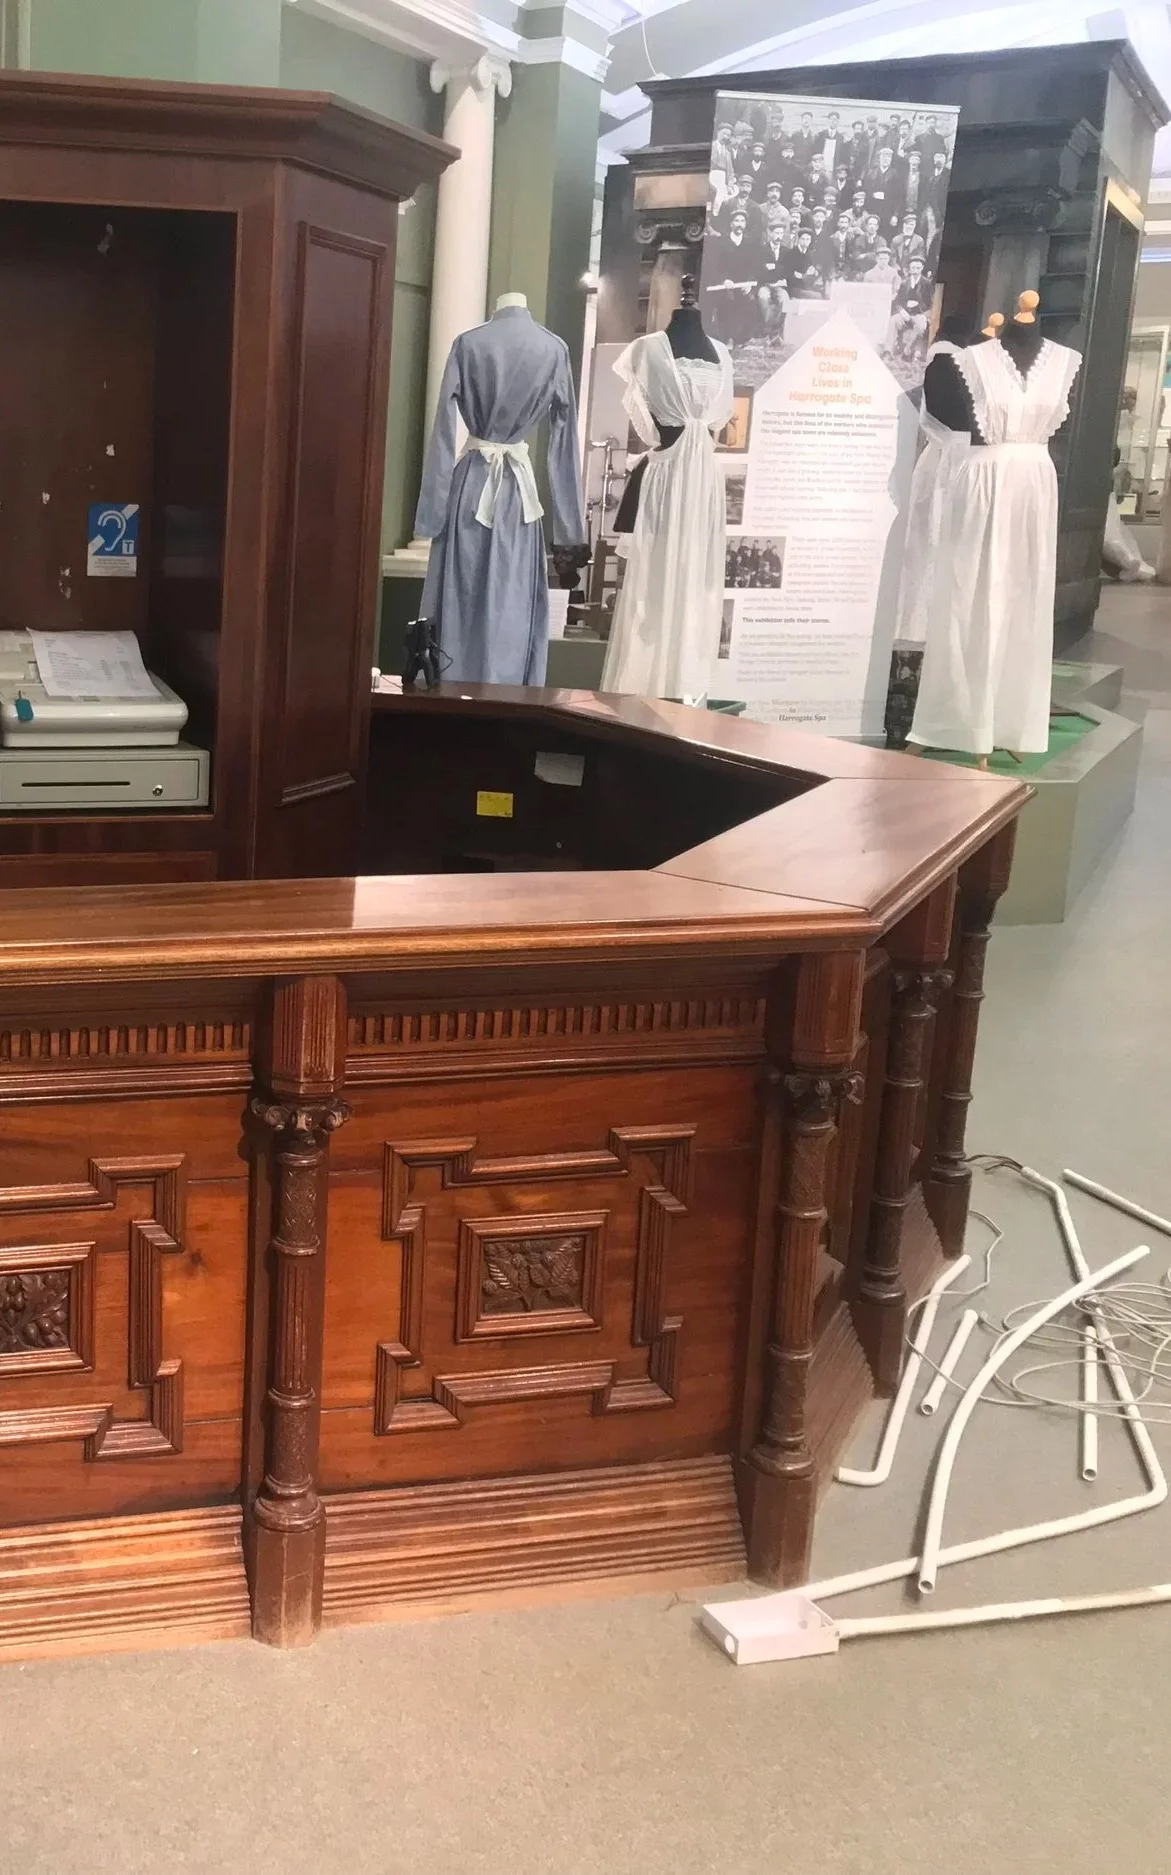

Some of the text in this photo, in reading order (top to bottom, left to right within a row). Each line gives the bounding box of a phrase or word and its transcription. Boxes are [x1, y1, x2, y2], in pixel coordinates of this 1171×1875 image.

[812, 346, 858, 361] Working
[818, 361, 849, 373] Class
[812, 376, 853, 388] Lives in
[788, 390, 873, 407] Harrogate Spa
